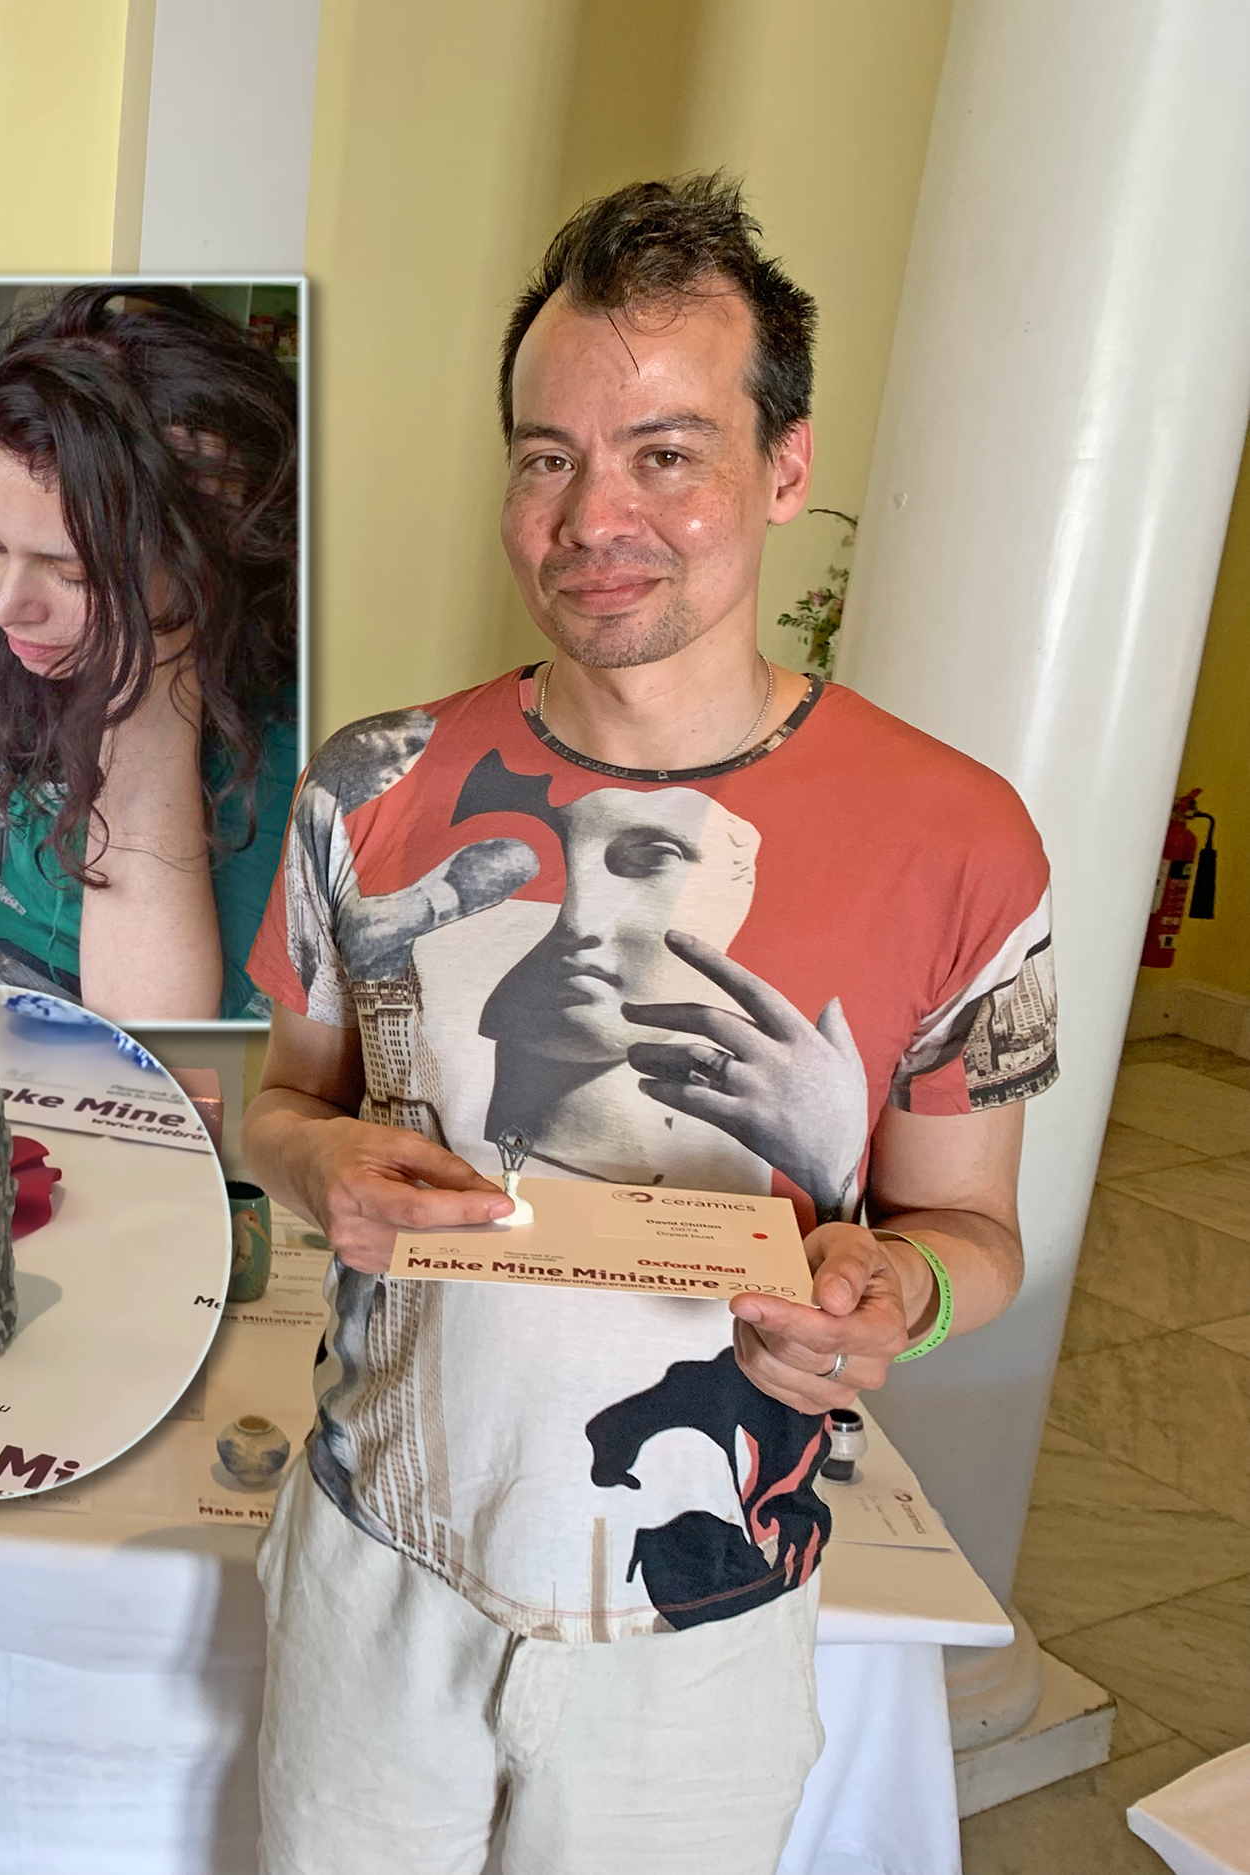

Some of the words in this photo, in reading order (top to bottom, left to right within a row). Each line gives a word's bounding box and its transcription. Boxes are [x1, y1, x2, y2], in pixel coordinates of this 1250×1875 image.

[0, 1088, 65, 1108] ake
[74, 1097, 186, 1127] Mine
[661, 1199, 756, 1212] ceramics
[646, 1219, 678, 1227] David
[408, 1247, 420, 1255] £
[637, 1259, 701, 1271] Oxford
[706, 1264, 747, 1275] Mail
[407, 1257, 484, 1271] Make
[492, 1261, 564, 1277] Mine
[572, 1267, 720, 1289] Miniature
[727, 1281, 797, 1298] 2025
[198, 1506, 244, 1518] Make
